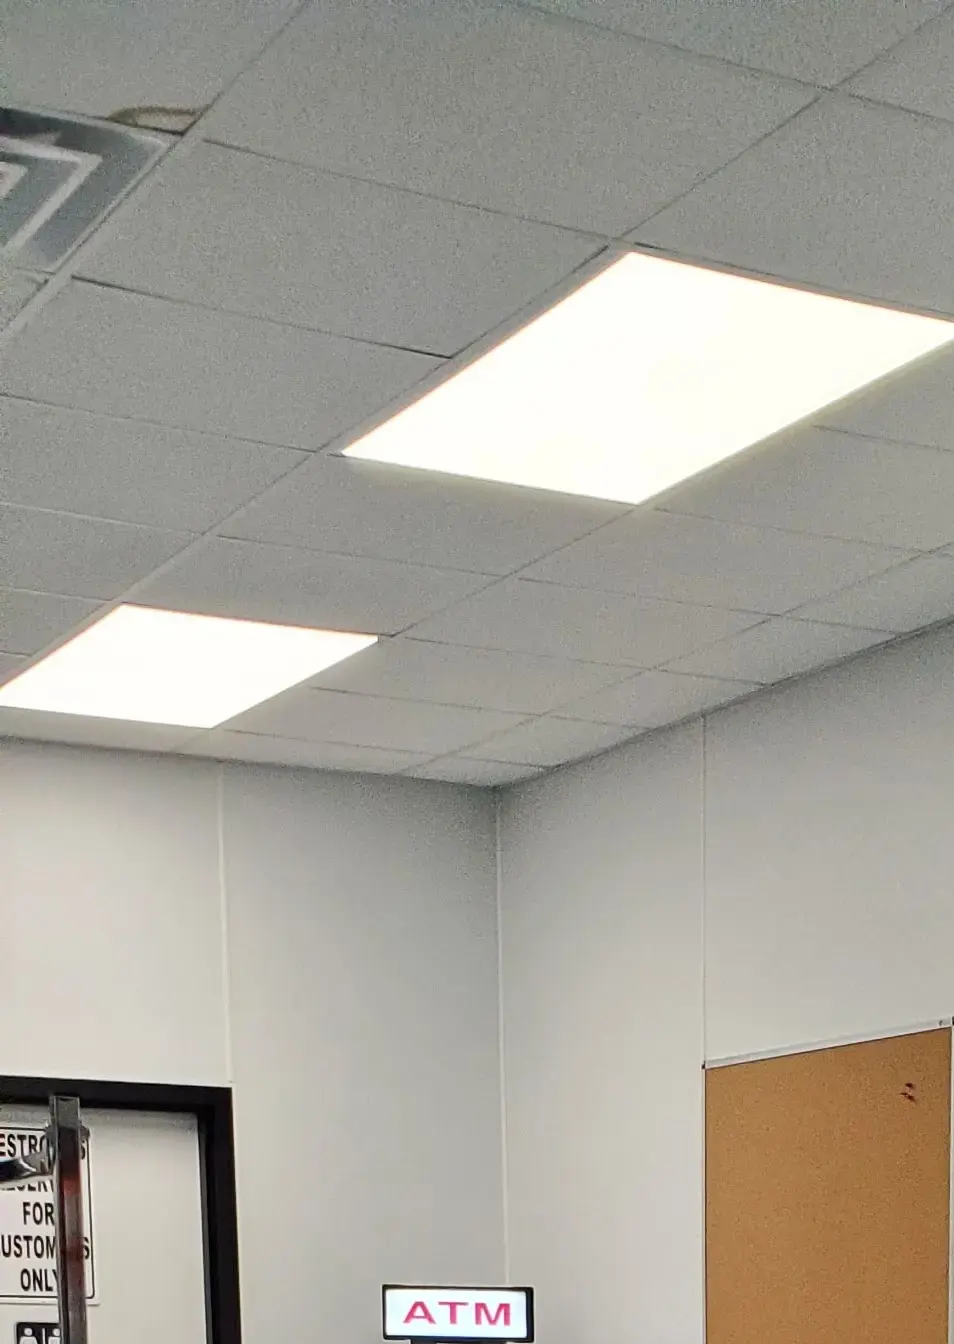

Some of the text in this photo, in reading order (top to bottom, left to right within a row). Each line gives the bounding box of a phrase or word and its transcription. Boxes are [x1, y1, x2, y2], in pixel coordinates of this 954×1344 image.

[22, 1201, 55, 1226] FOR
[0, 1234, 90, 1260] USTOMS
[402, 1300, 511, 1326] ATM
